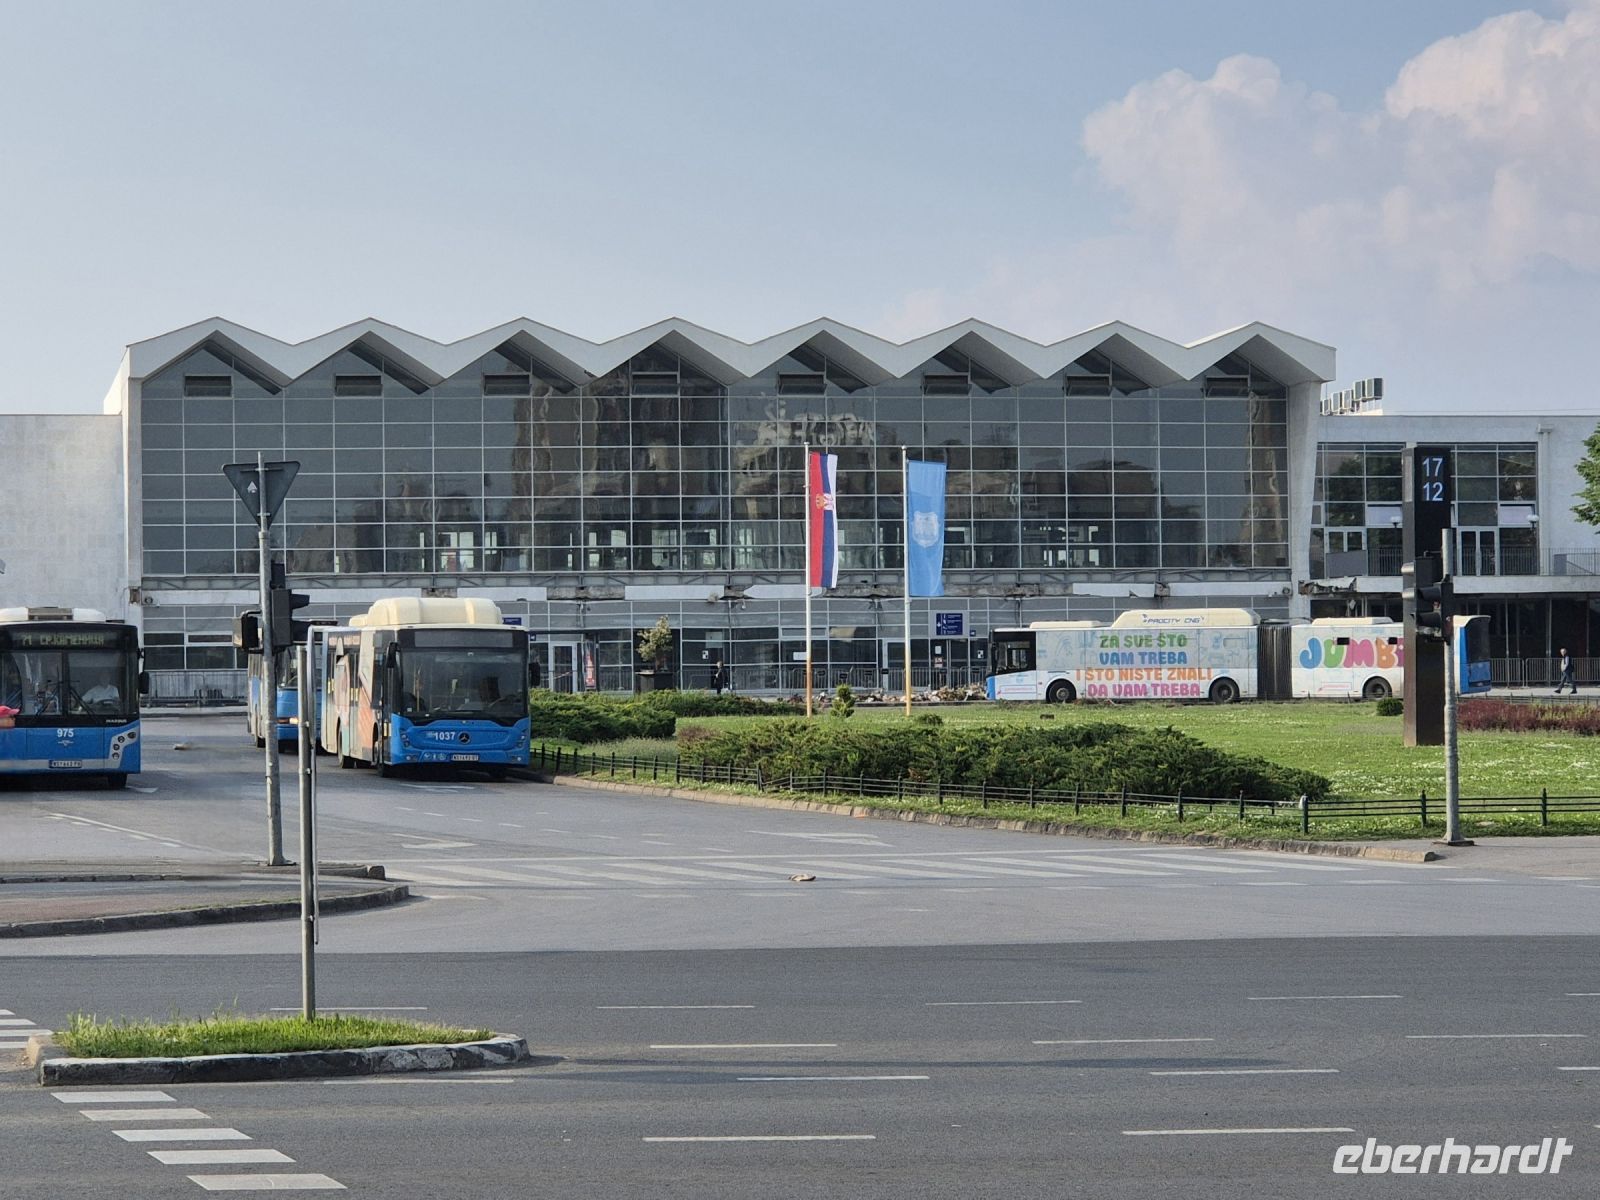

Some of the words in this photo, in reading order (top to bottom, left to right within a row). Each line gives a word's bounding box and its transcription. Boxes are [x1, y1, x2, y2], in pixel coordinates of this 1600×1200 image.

[1423, 457, 1443, 477] 17
[1423, 481, 1443, 501] 12
[1100, 635, 1119, 648] ZA
[1124, 635, 1152, 648] SVE
[1157, 632, 1188, 648] ŠTO
[1100, 652, 1134, 665] VAM
[1138, 652, 1187, 665] TREBA
[1299, 637, 1404, 669] JUMB
[1076, 669, 1081, 681] I
[1085, 666, 1114, 681] ŠTO
[1119, 668, 1163, 681] NISTE
[1167, 667, 1213, 681] ZNALI
[1087, 683, 1108, 696] DA
[1112, 683, 1148, 696] VAM
[1151, 683, 1201, 696] TREBA
[57, 728, 74, 738] 975
[434, 731, 456, 740] 1037
